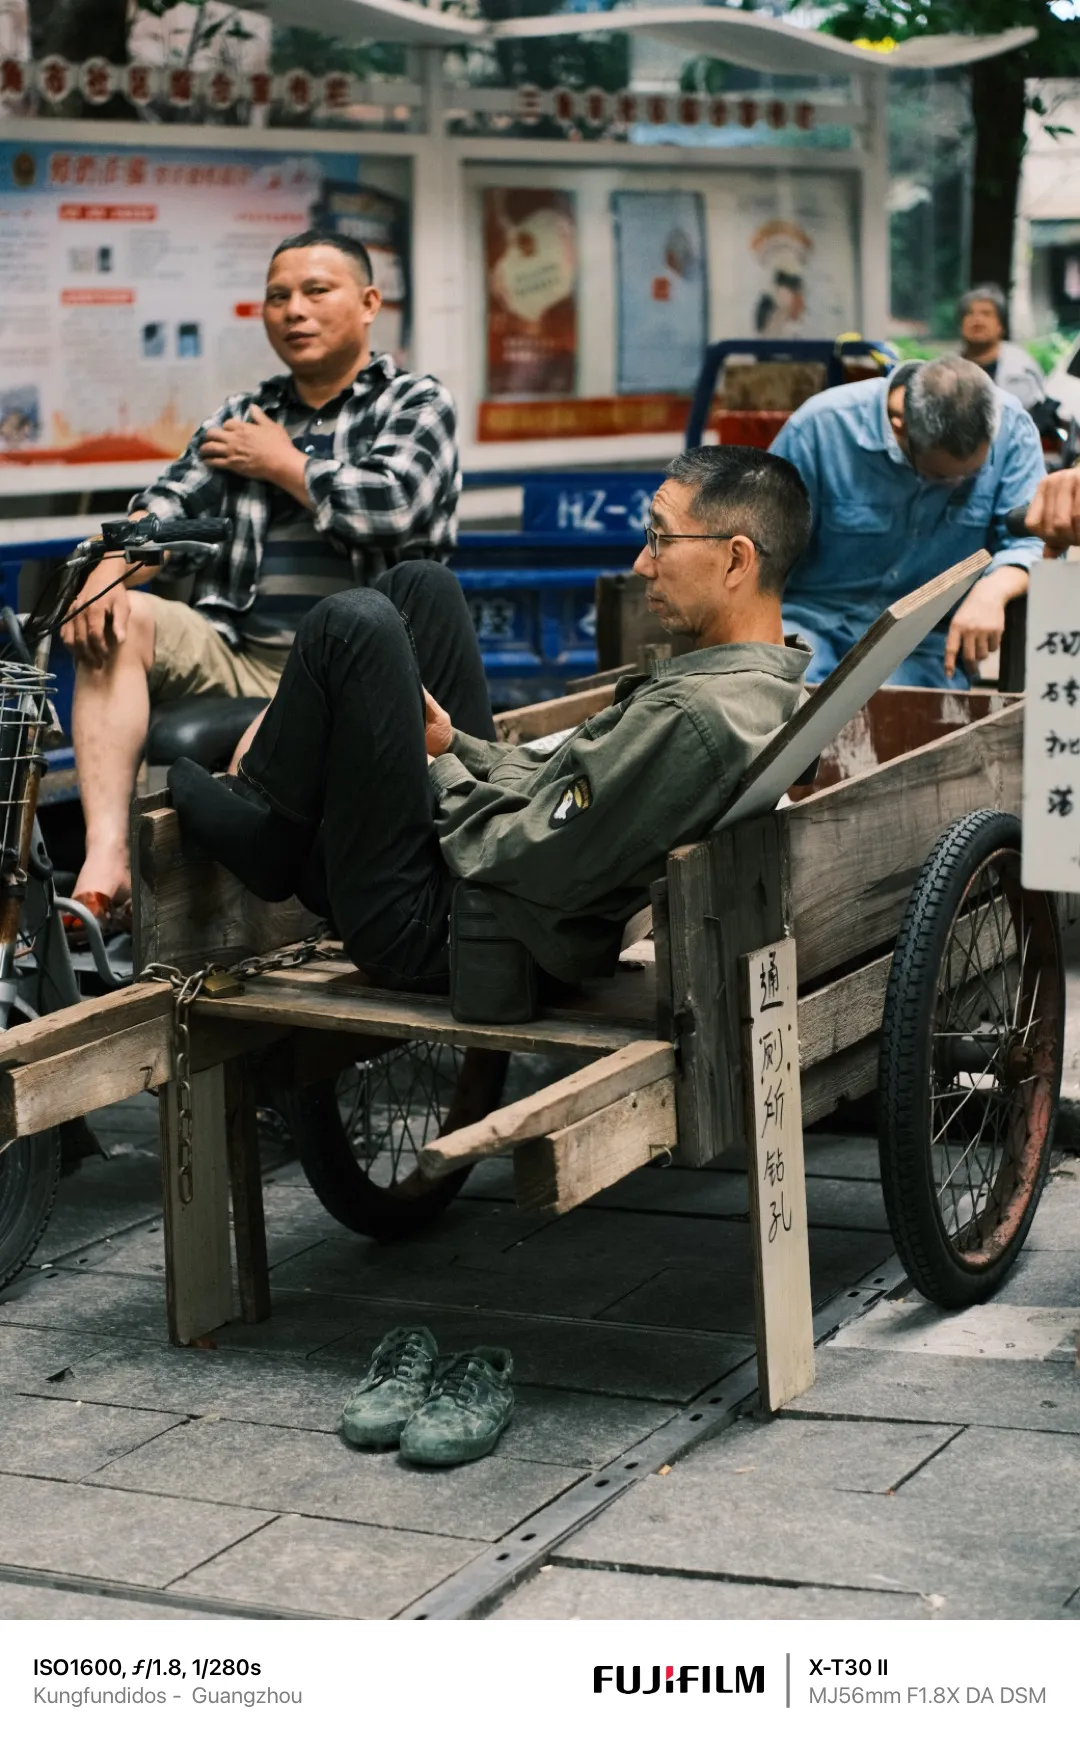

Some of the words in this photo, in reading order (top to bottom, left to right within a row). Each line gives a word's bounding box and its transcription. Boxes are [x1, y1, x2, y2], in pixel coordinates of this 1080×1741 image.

[758, 951, 792, 1243] 通厕所钻孔
